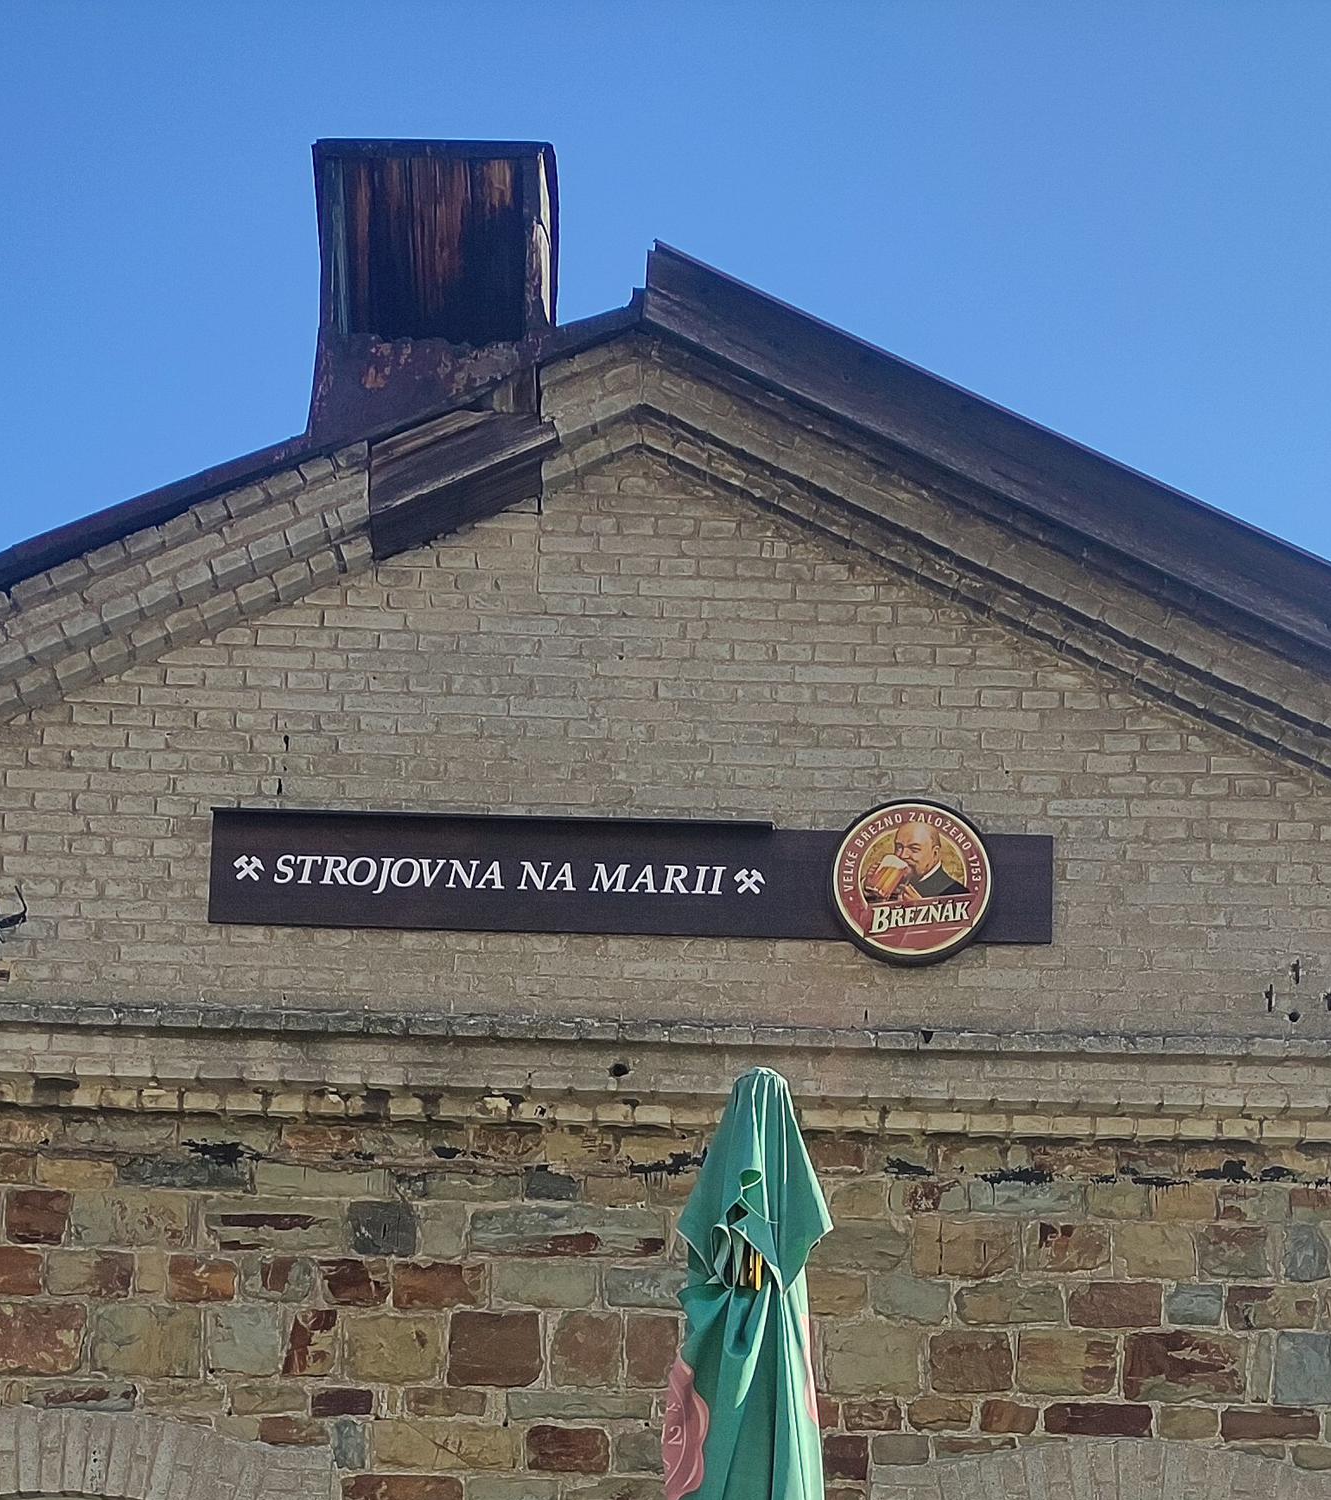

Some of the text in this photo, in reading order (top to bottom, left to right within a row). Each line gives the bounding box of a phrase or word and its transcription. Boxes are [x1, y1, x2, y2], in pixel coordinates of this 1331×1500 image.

[909, 812, 972, 851] ZALOŽENO
[967, 854, 982, 882] 1753
[273, 854, 727, 895] STROJOVNA NA MARII
[869, 900, 970, 934] BŘEZŇÁK
